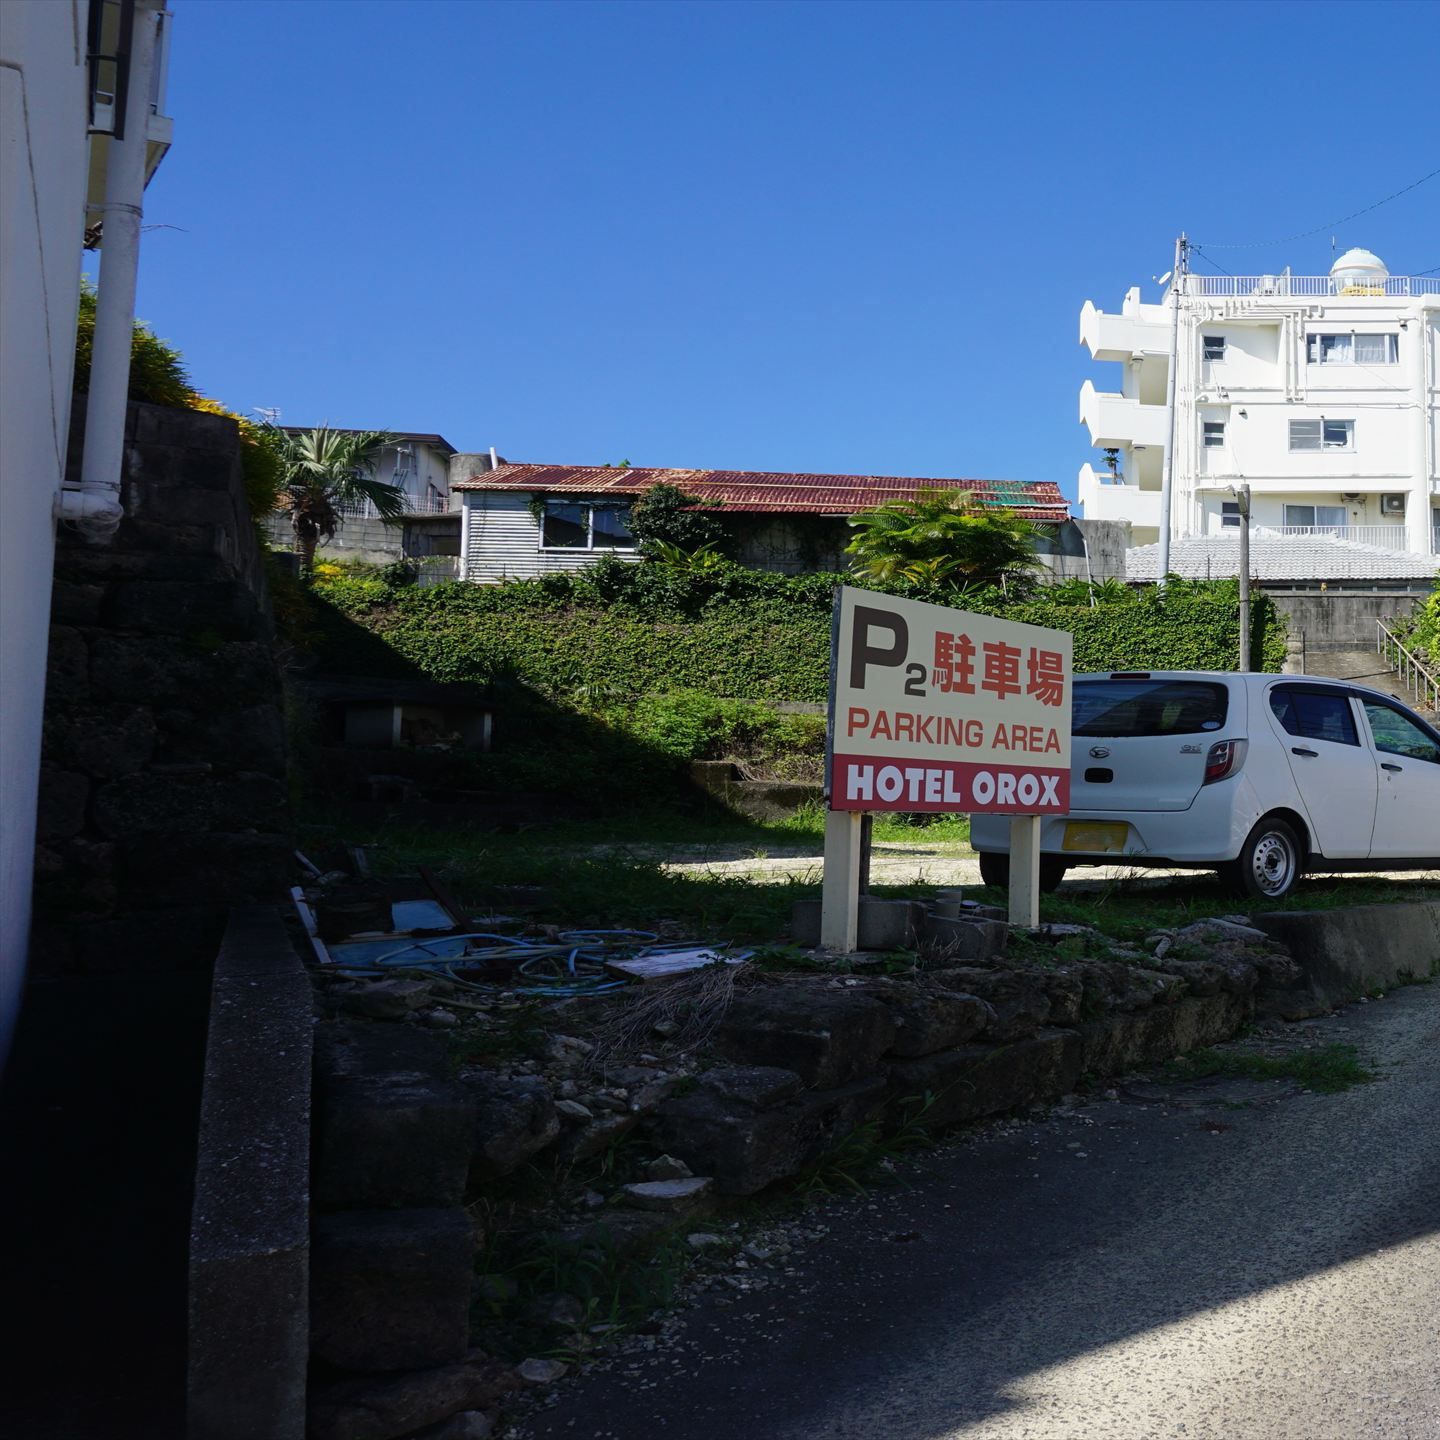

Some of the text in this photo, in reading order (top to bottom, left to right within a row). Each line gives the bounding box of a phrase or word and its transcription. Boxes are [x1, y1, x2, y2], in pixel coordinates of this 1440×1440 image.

[932, 630, 1064, 707] 駐車場
[847, 706, 1061, 754] PARKING AREA
[847, 764, 1061, 806] HOTEL OROX
